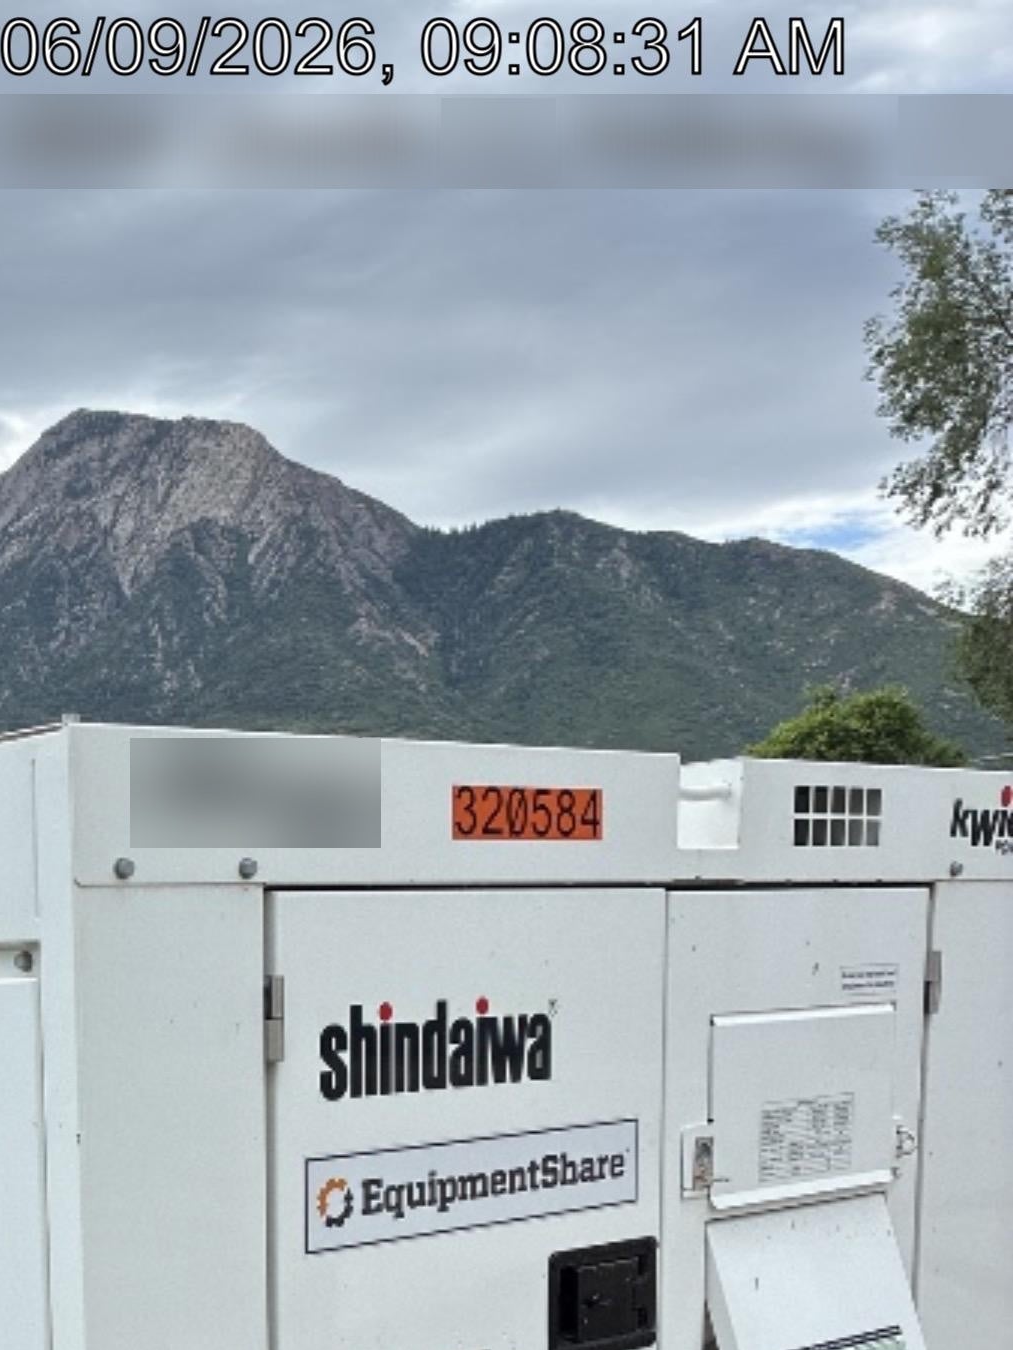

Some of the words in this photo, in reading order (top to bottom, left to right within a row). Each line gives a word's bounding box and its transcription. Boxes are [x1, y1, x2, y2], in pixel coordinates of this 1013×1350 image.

[454, 785, 602, 839] 320584
[319, 996, 552, 1101] shindaiwa
[360, 1152, 625, 1218] EquipmentShare
